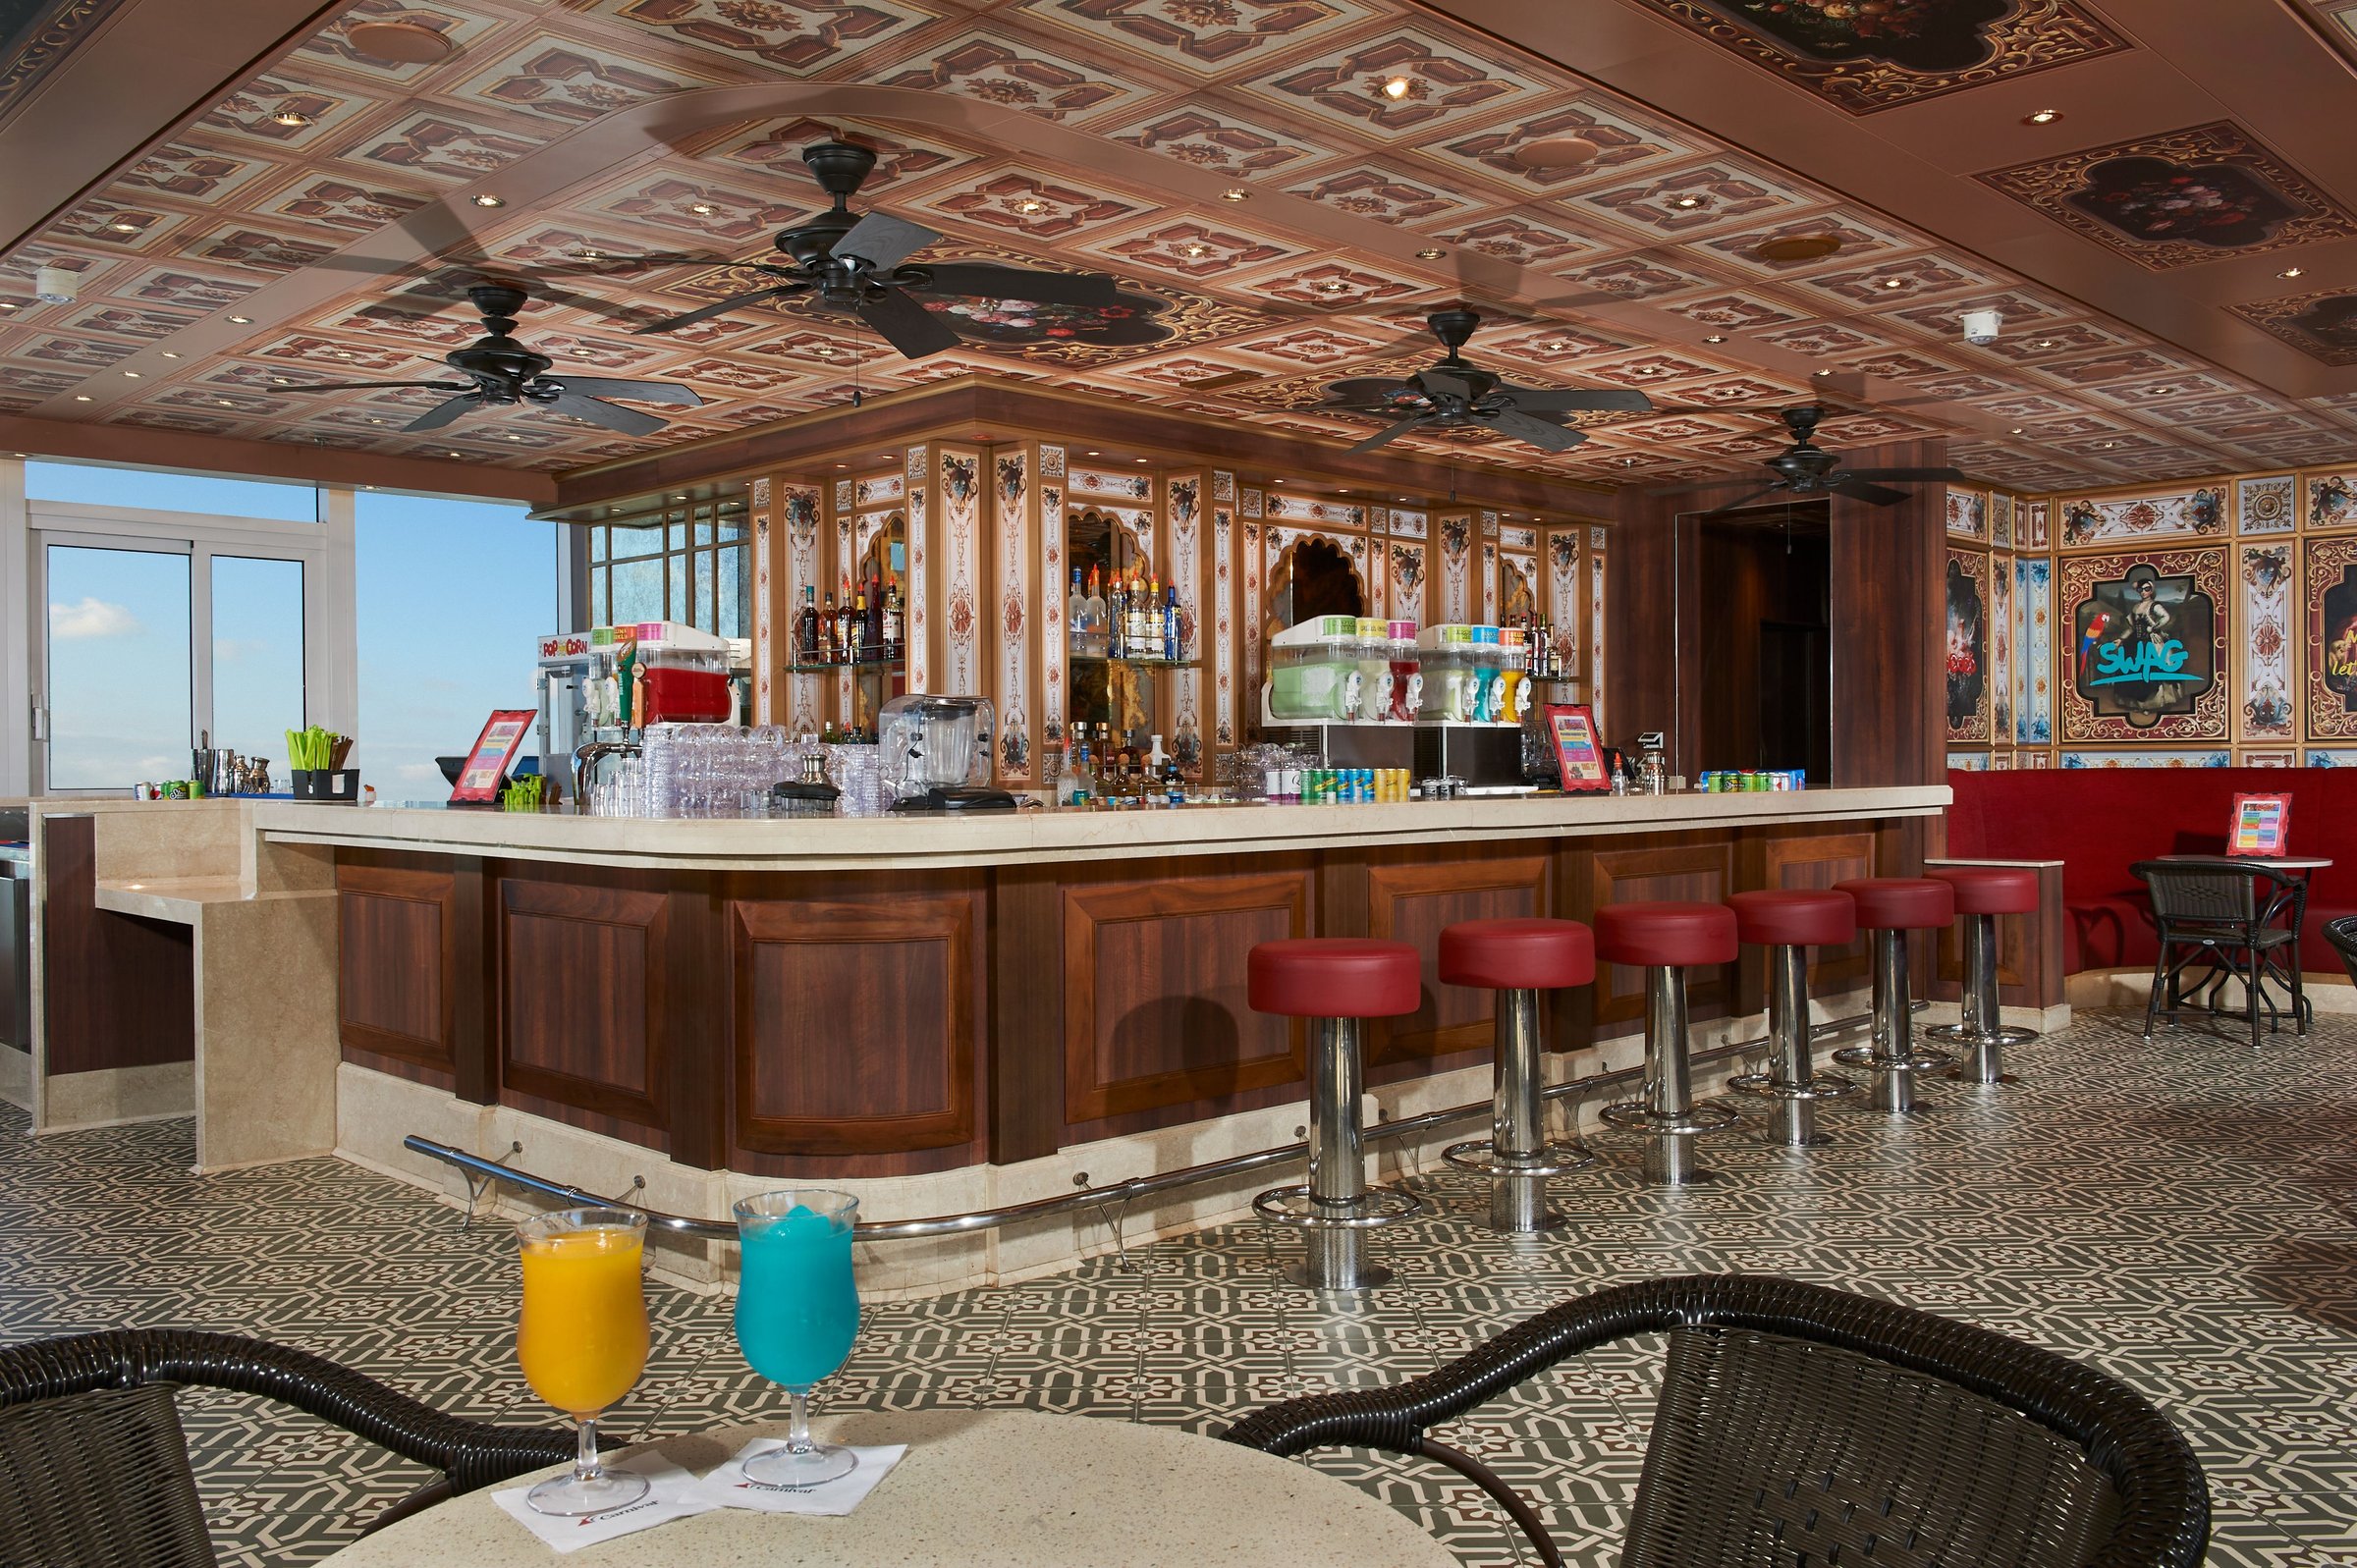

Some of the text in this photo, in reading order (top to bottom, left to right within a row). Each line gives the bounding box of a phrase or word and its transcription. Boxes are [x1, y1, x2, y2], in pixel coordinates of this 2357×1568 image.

[543, 638, 587, 657] POP CORN
[2097, 639, 2189, 683] SWAG
[755, 1484, 813, 1493] Carnival
[600, 1499, 659, 1521] Carnival
